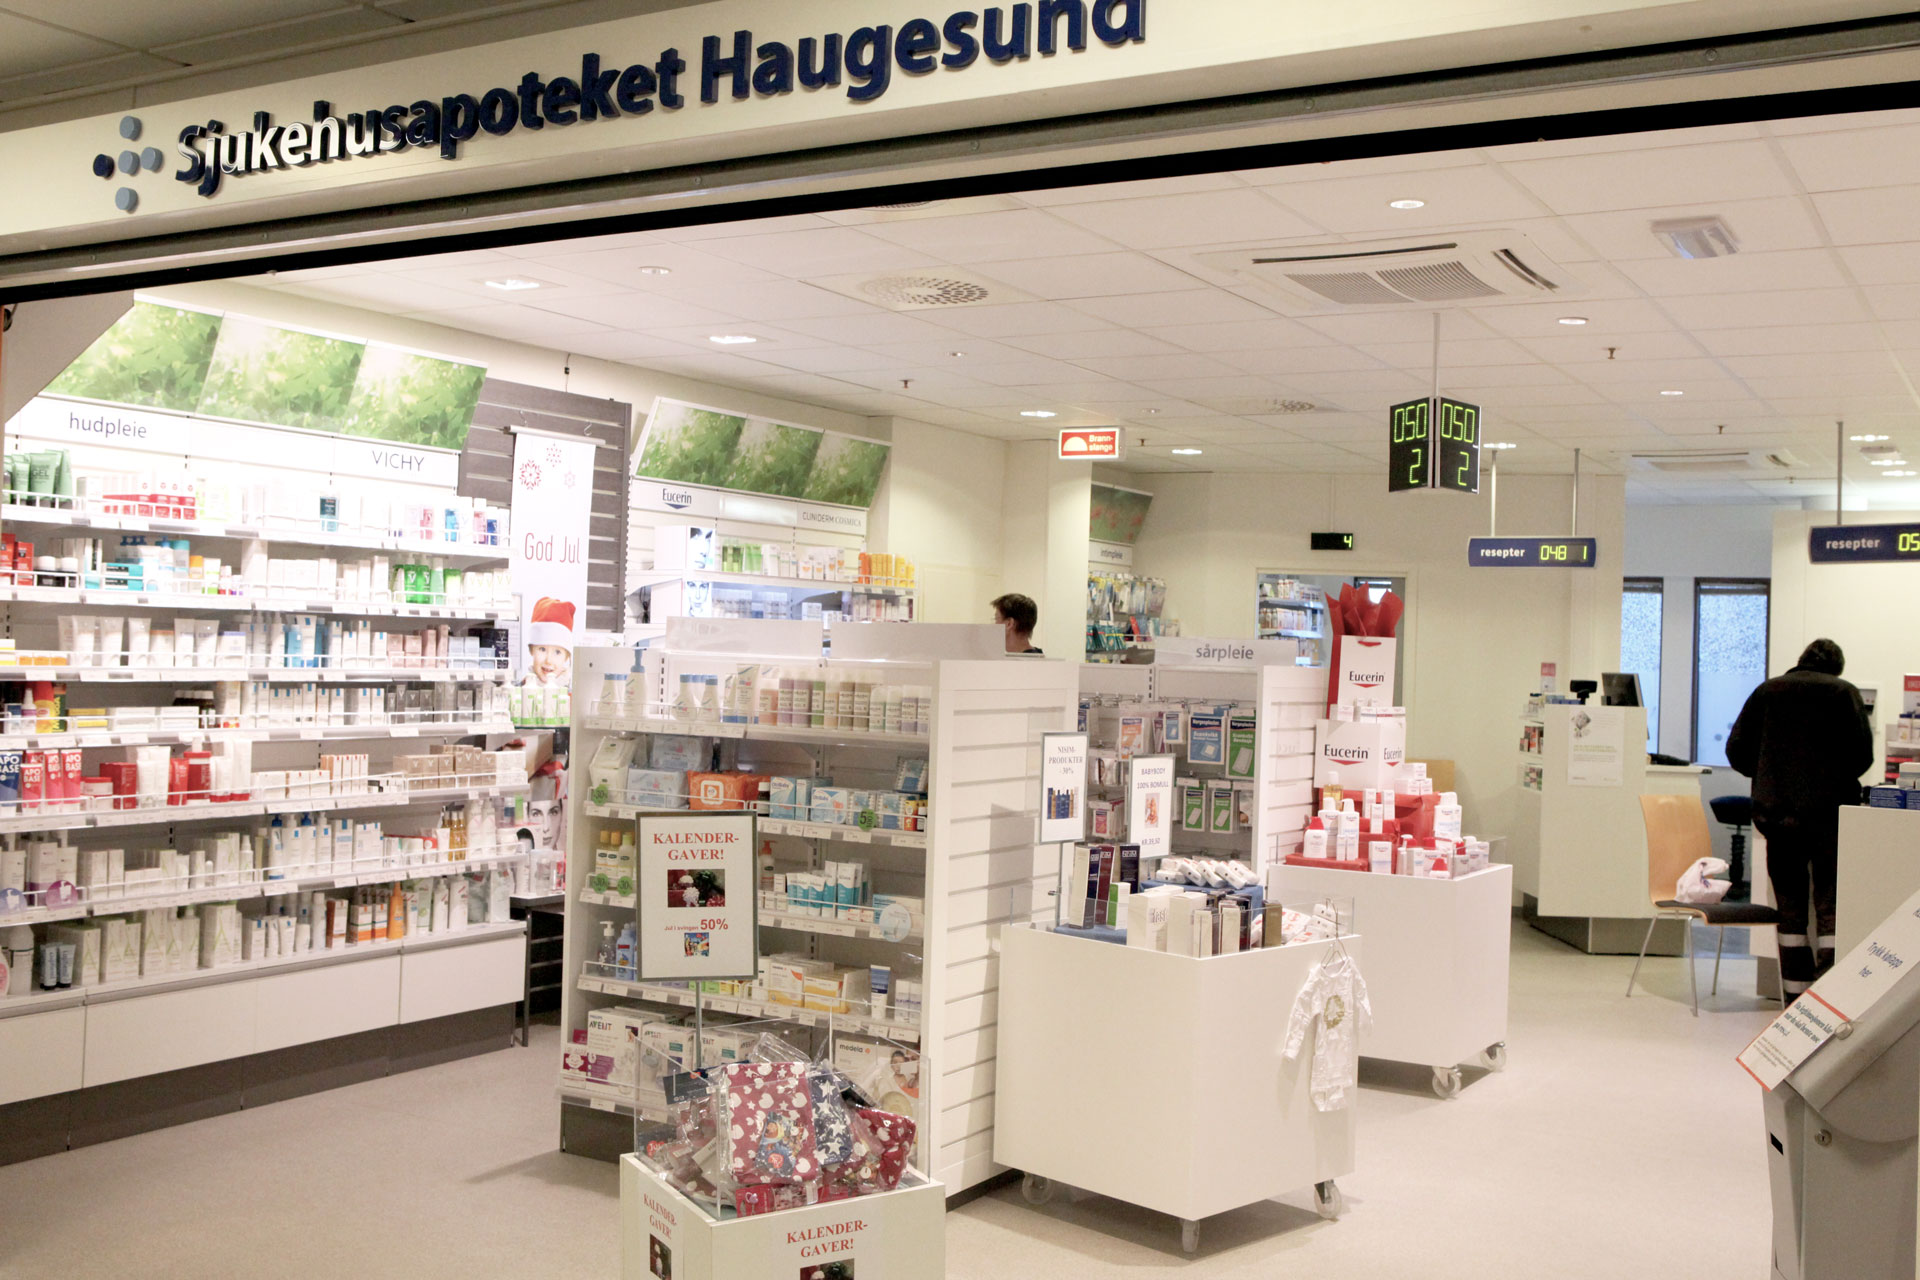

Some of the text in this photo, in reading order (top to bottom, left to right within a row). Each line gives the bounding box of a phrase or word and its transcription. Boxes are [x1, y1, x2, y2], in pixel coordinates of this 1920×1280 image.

[175, 0, 1147, 196] Sjukehusapoteket Haugesund
[69, 411, 147, 438] hudpleie
[1394, 403, 1427, 443] 050
[1441, 403, 1475, 443] 050
[1089, 434, 1114, 443] Brann-
[372, 450, 425, 472] VICHY
[1409, 448, 1421, 484] 2
[1458, 451, 1470, 486] 2
[662, 488, 692, 505] Eucerin
[802, 511, 834, 523] CLINIDERM
[525, 532, 580, 564] God Jul
[1344, 535, 1352, 548] 4
[1825, 538, 1881, 551] resepter
[1480, 548, 1526, 559] resepter
[1540, 544, 1588, 560] 048 1
[1195, 643, 1254, 662] sårpleie
[1349, 670, 1384, 682] Eucerin
[1324, 744, 1369, 759] Eucerin
[1384, 746, 1402, 760] Eucerin
[0, 765, 20, 773] ASE
[653, 832, 740, 844] KALENDER-
[668, 849, 724, 860] GAVER!
[700, 918, 729, 931] 50%
[839, 1043, 863, 1053] medela
[643, 1192, 677, 1226] KALENDER-
[649, 1214, 672, 1240] GAVER!
[787, 1219, 868, 1244] KALENDER-
[800, 1238, 854, 1258] GAVER!
